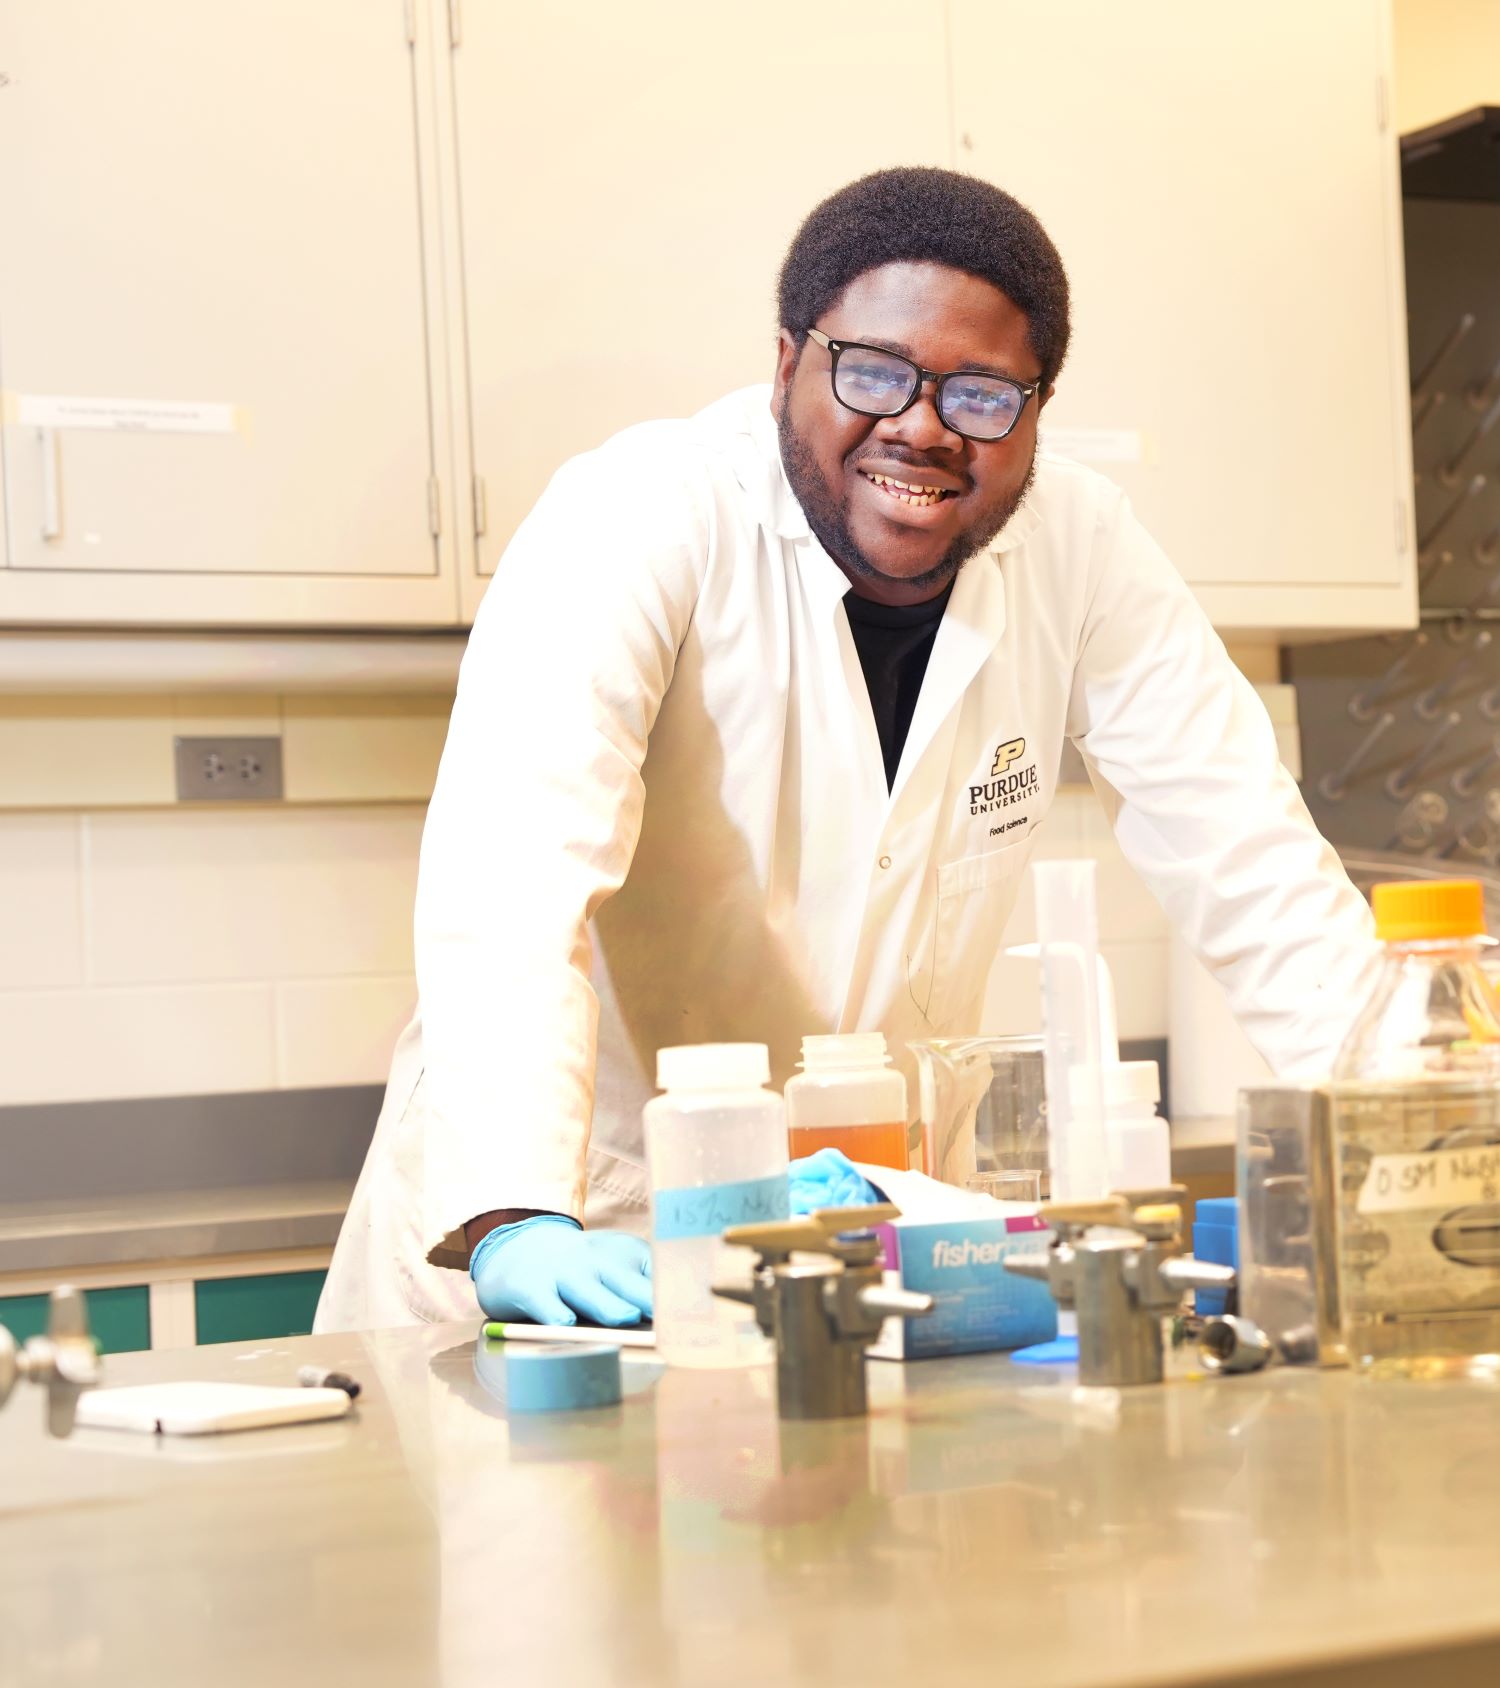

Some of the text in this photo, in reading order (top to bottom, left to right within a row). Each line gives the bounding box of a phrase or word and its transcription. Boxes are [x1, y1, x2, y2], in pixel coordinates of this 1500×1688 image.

[991, 737, 1025, 776] P
[969, 764, 1037, 804] PURDUE
[989, 816, 1027, 836] Food Science
